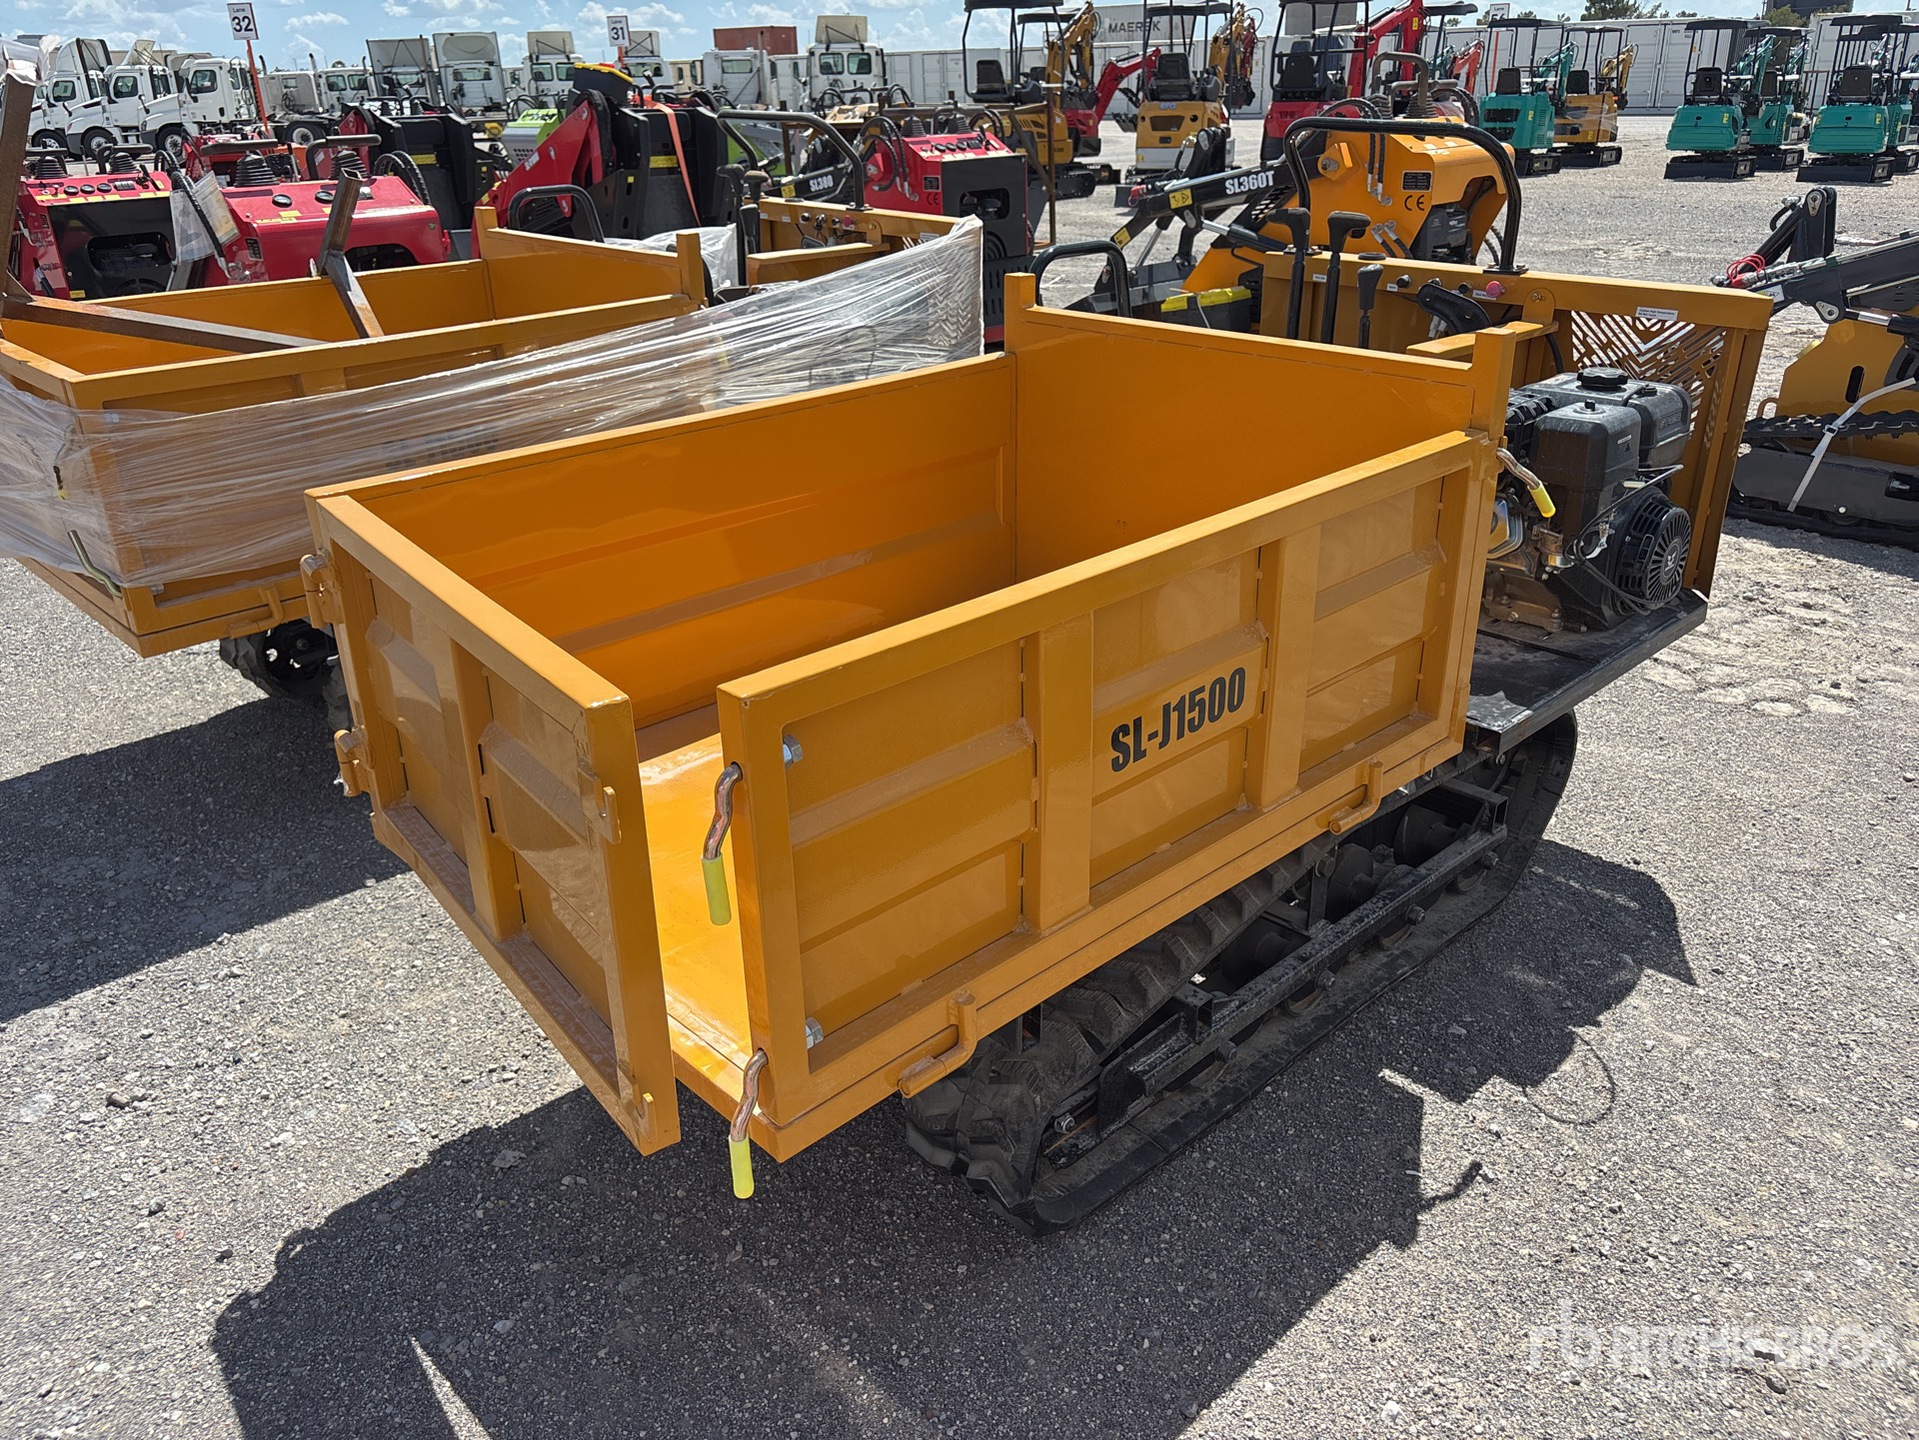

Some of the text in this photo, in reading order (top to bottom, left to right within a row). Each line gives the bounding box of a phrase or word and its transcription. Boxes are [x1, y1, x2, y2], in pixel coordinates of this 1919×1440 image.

[231, 15, 254, 33] 32
[610, 26, 626, 41] 31
[1225, 170, 1275, 195] SL360T
[1110, 666, 1246, 773] SL-J1500
